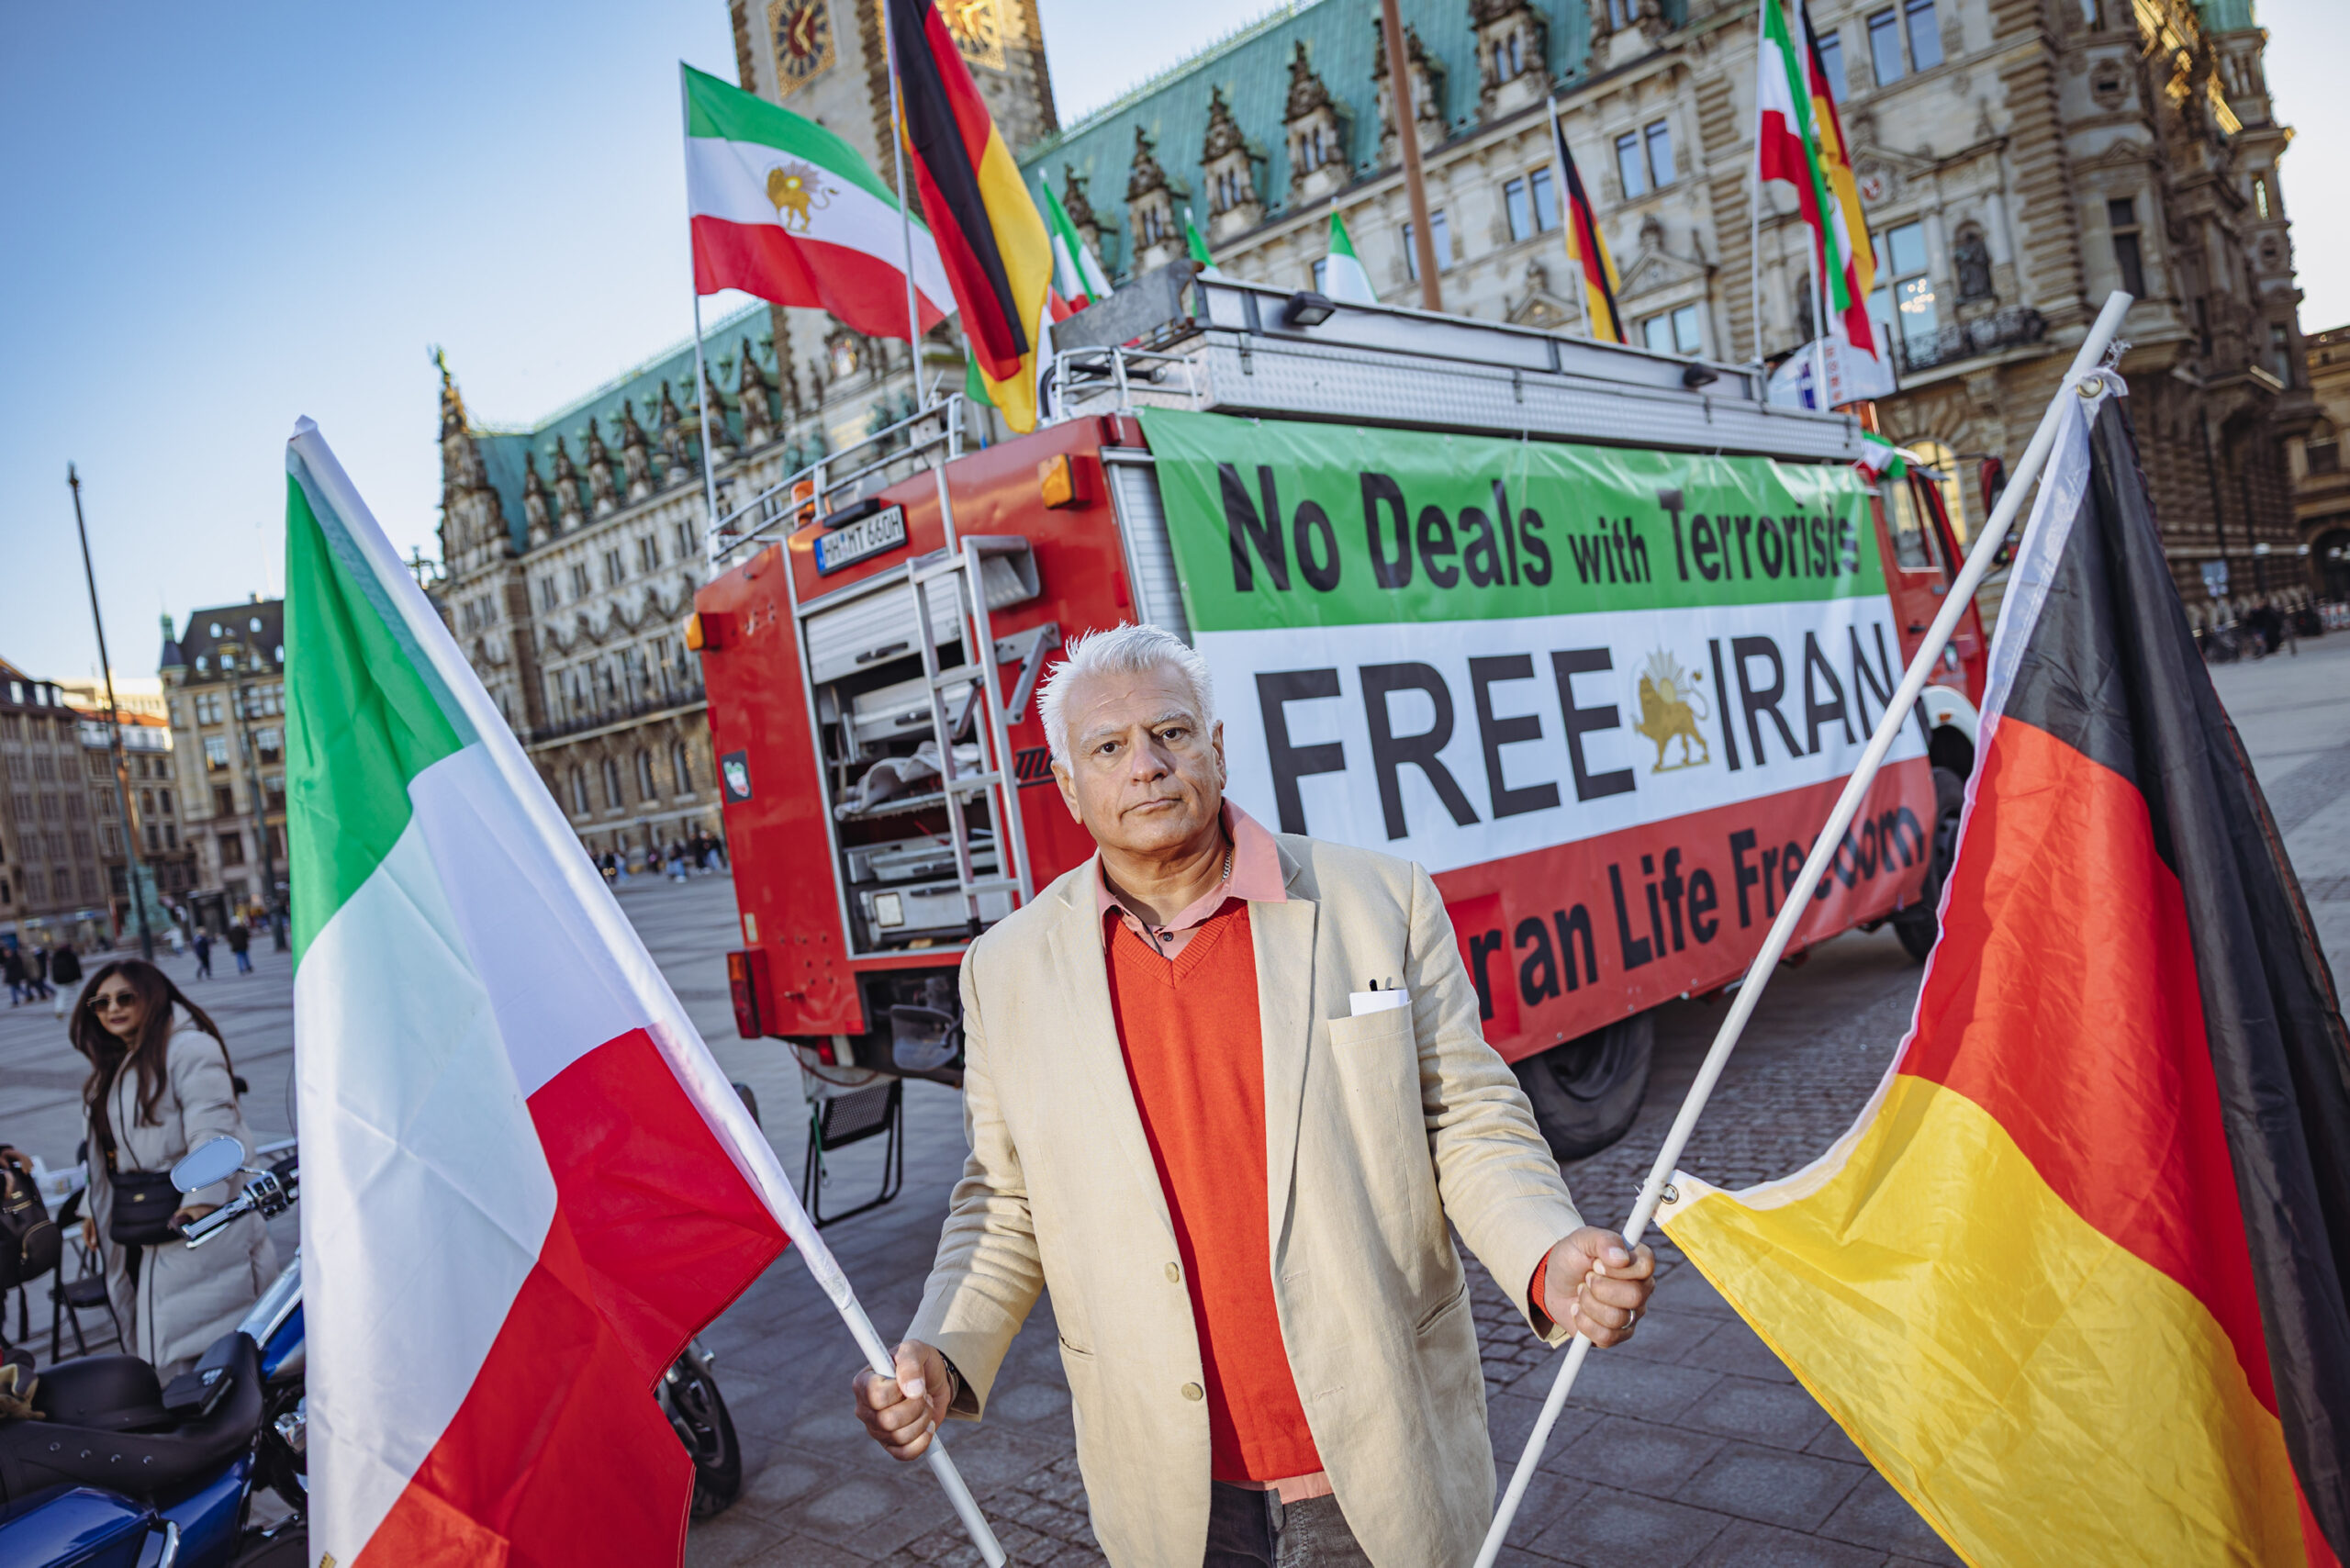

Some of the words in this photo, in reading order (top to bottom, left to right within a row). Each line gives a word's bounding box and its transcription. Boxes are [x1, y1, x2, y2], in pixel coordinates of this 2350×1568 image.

[1218, 462, 1340, 592] No
[1360, 471, 1552, 589] Deals
[1568, 516, 1650, 584] with
[1656, 489, 1860, 581] Terrorists
[1255, 647, 1637, 841] FREE
[1708, 622, 1902, 772] IRAN
[1469, 902, 1598, 1022] ran
[1607, 846, 1718, 971] Life
